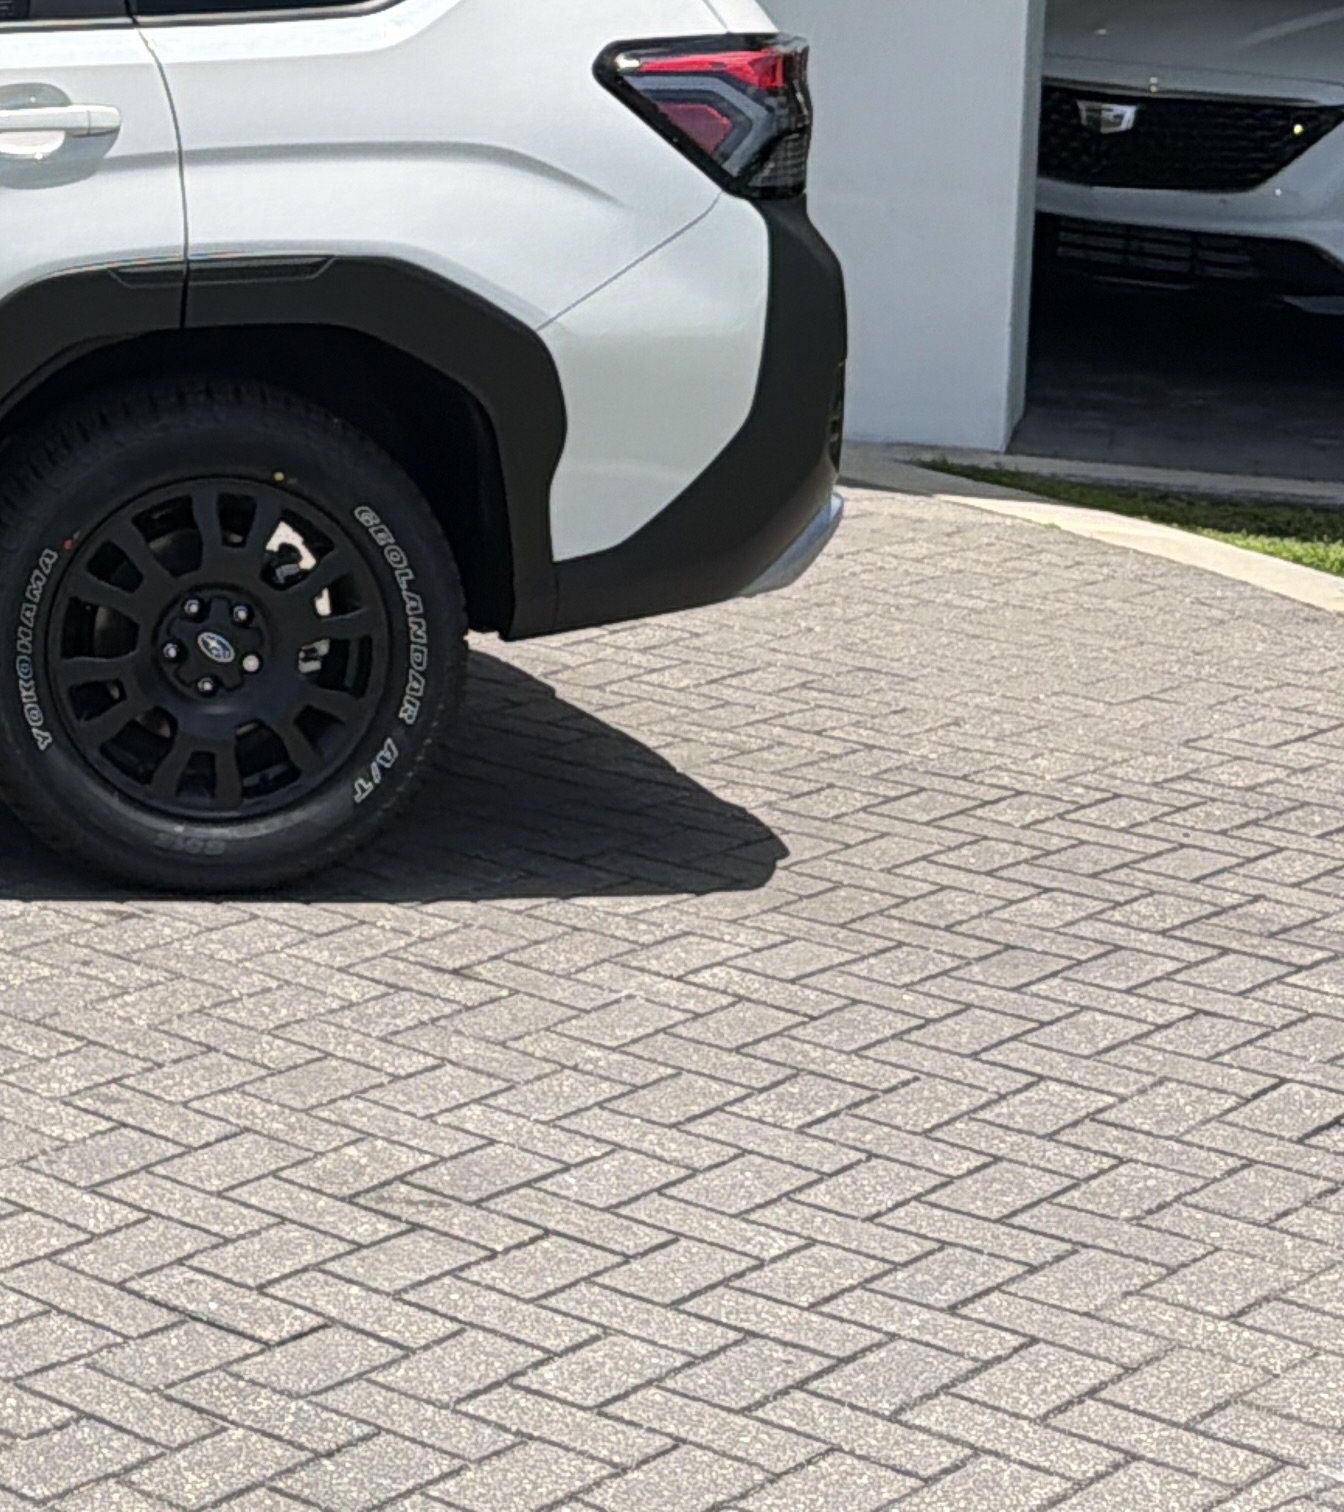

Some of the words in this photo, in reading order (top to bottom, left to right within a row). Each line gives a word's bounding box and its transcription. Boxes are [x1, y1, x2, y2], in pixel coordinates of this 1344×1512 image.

[15, 547, 59, 752] YOKOHAMA
[354, 505, 432, 727] GEOLANDAR
[353, 737, 400, 804] A/T
